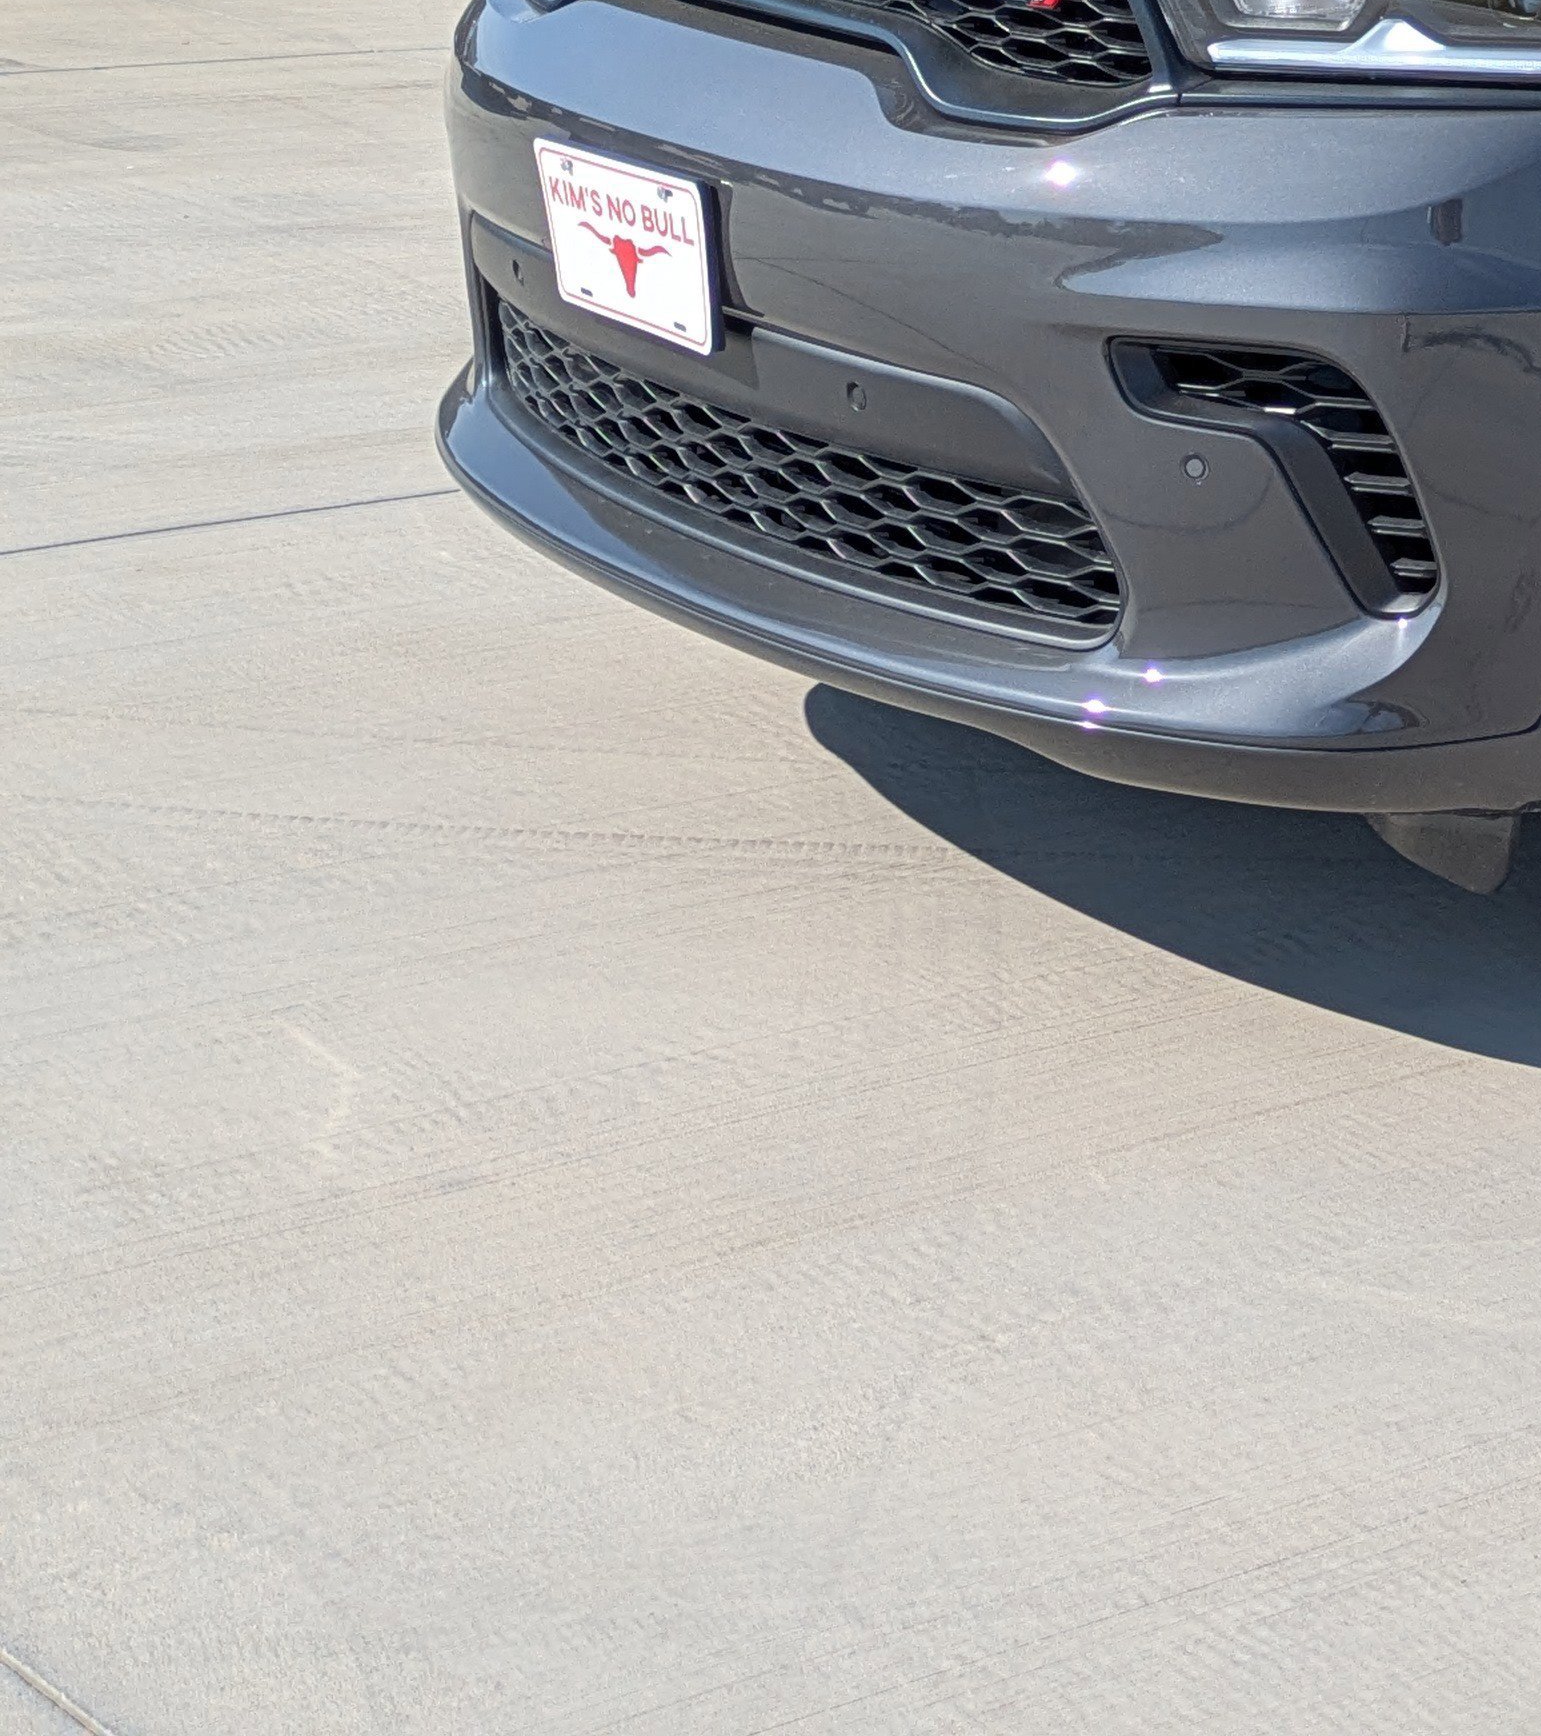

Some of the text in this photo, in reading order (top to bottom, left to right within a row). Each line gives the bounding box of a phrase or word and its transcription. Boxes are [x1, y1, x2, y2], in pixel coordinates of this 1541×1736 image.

[549, 176, 695, 246] KIM'S NO BULL
